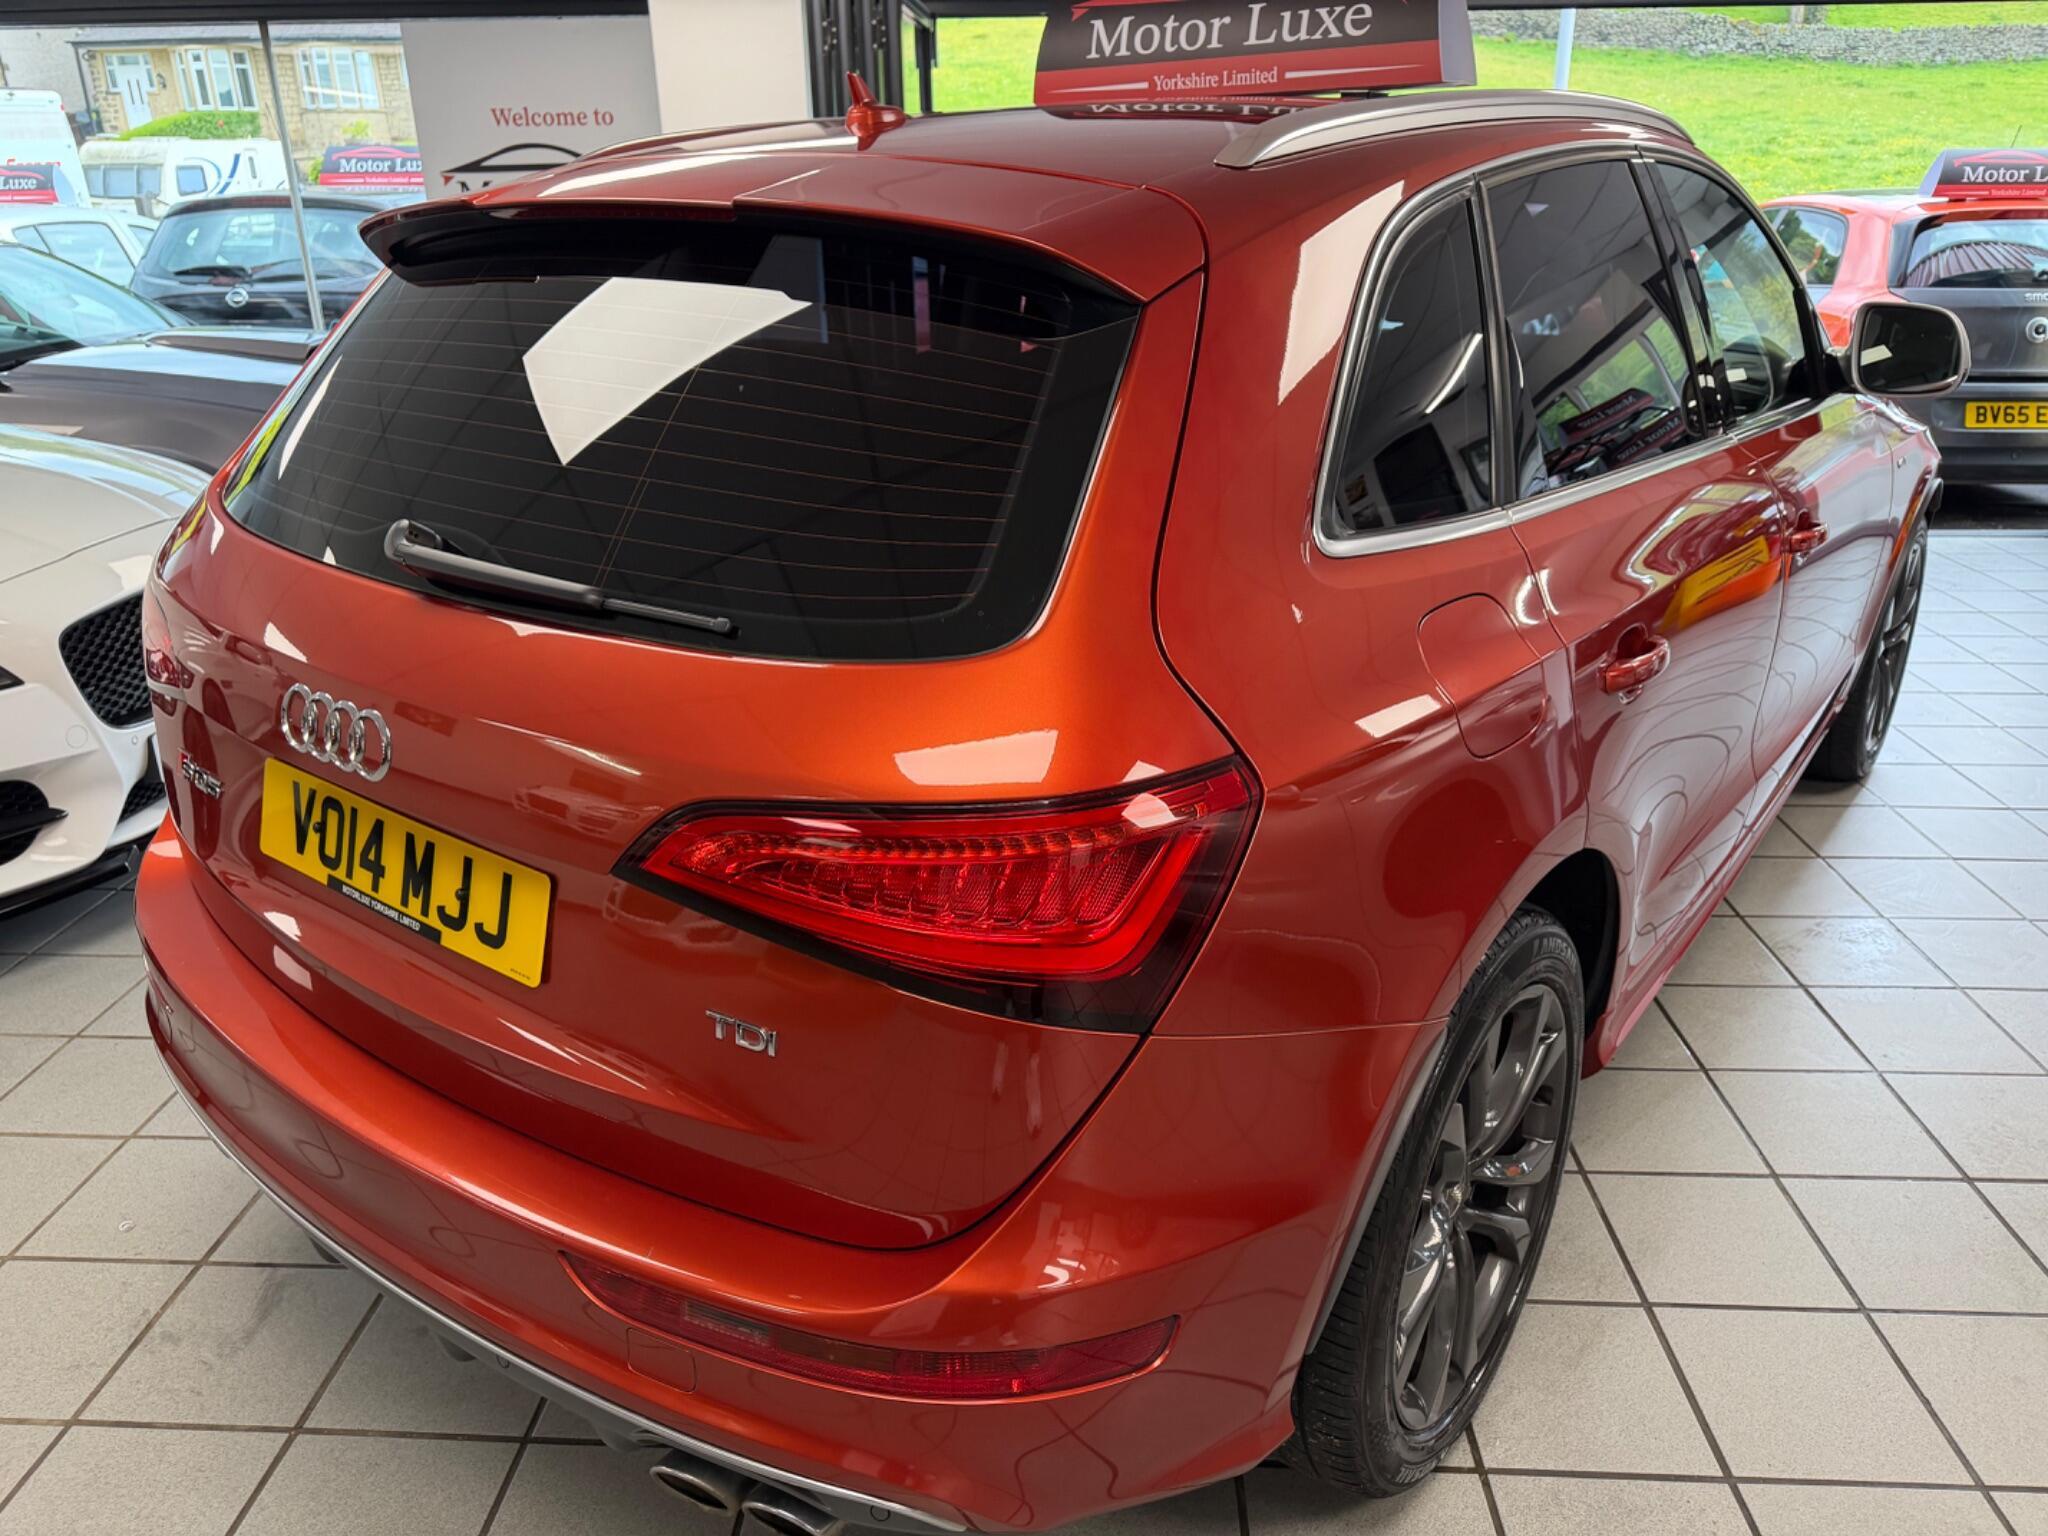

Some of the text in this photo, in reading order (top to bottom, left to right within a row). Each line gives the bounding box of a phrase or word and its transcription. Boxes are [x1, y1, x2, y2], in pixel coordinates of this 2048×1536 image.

[1086, 2, 1374, 60] Motor Luxe
[1154, 66, 1278, 91] Yorkshire Limited
[490, 106, 614, 127] Welcome to
[338, 158, 392, 173] Motor
[1961, 165, 2030, 183] Motor
[0, 177, 37, 190] Luxe
[1975, 405, 2030, 424] BV65
[292, 780, 513, 950] VO14 MJJ
[704, 1008, 777, 1058] TDI
